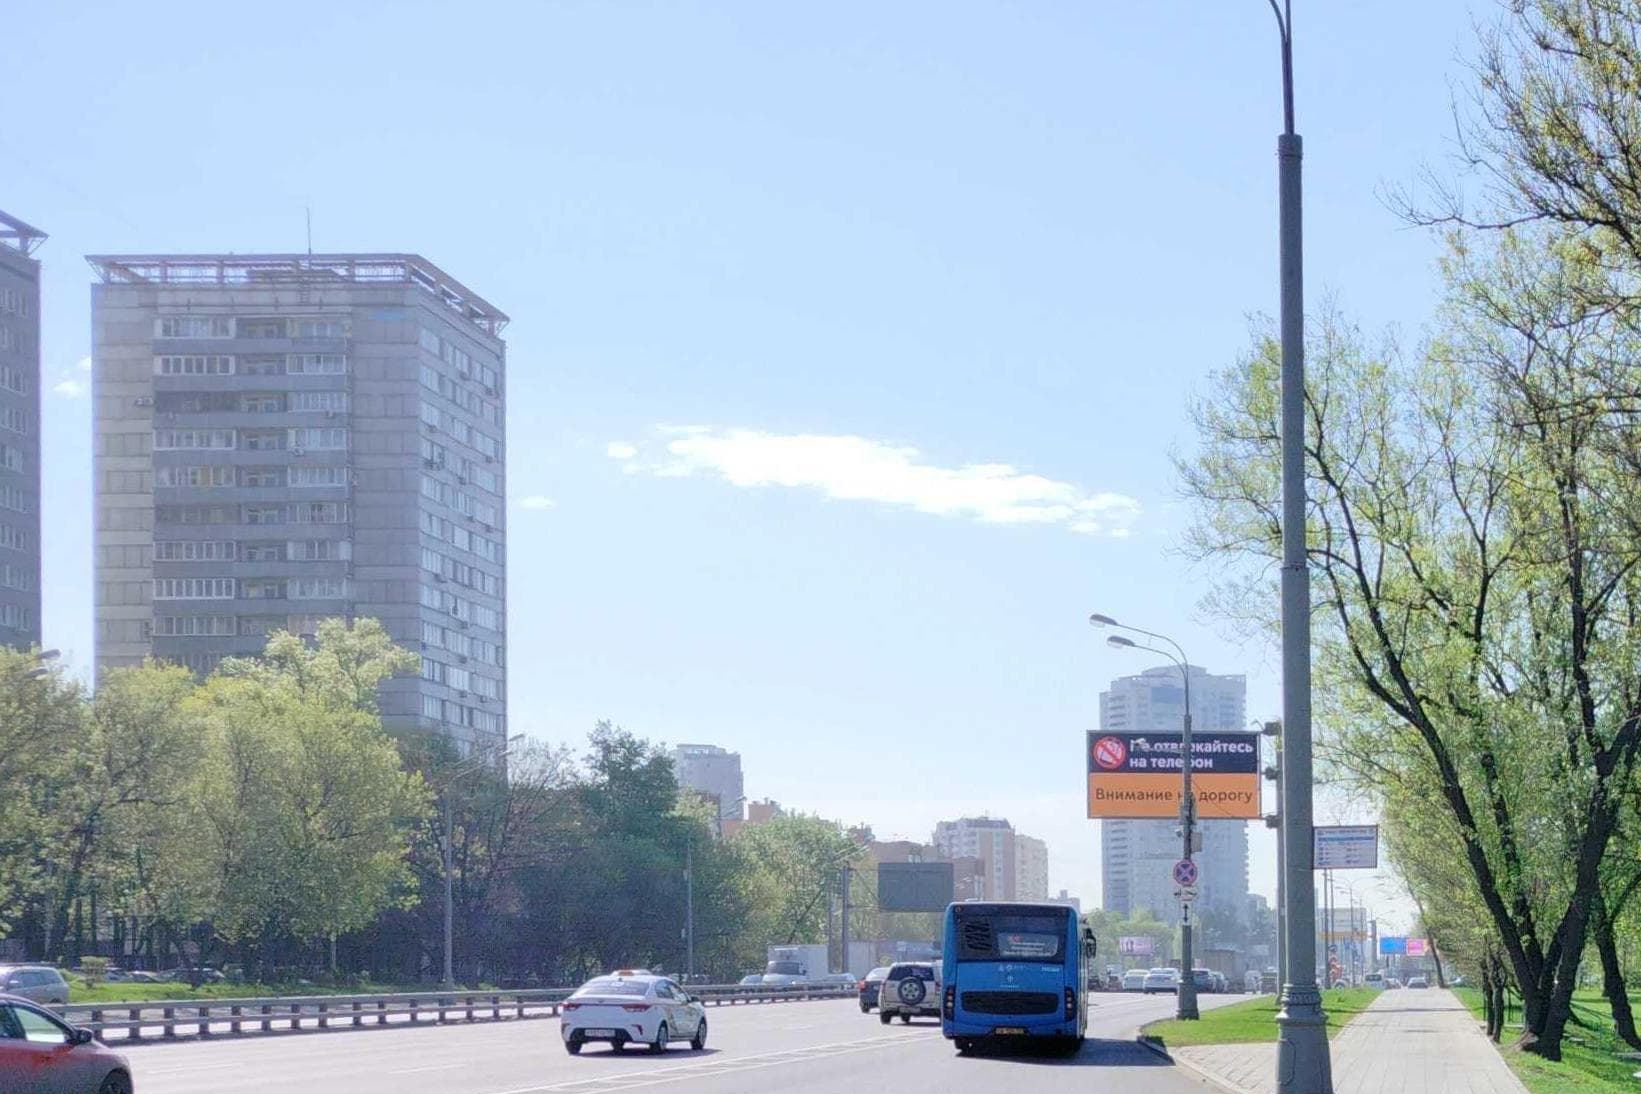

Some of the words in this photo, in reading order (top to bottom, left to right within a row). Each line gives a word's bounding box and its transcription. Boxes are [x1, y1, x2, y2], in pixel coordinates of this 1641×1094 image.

[1129, 757, 1147, 769] на
[1095, 788, 1173, 801] Внимание
[1198, 791, 1253, 803] дорогу
